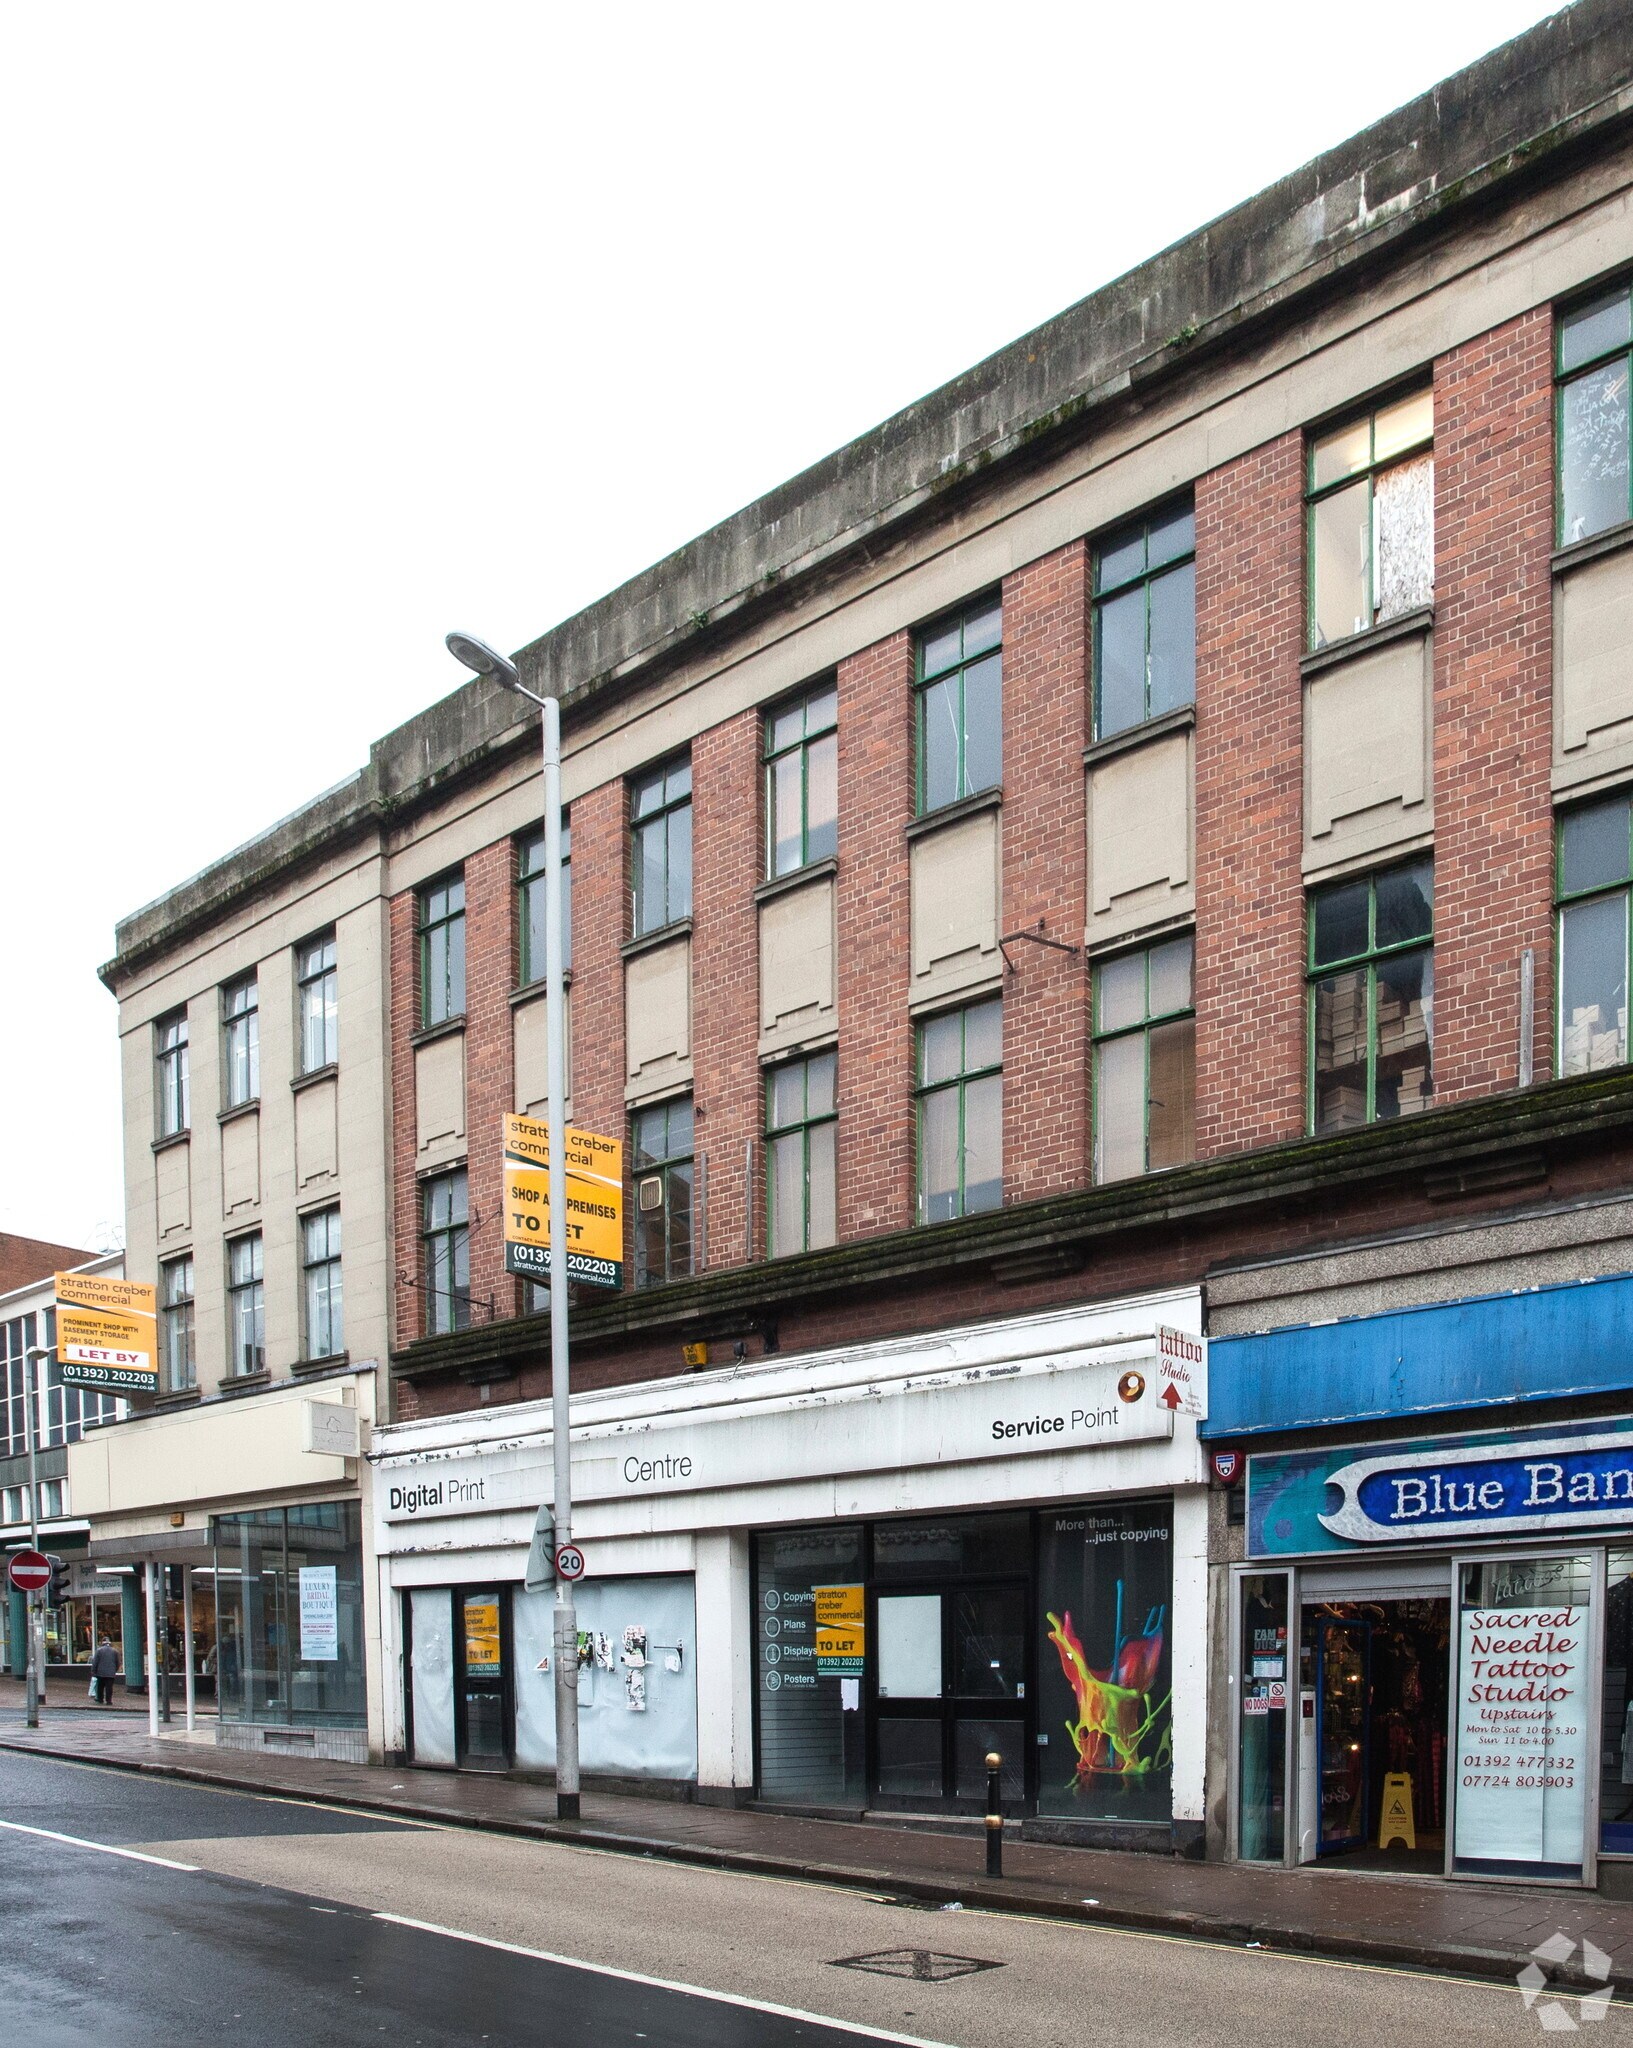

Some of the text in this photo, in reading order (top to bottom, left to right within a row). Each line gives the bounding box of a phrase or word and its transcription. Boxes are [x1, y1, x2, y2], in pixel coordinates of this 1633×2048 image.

[511, 1121, 616, 1154] stratt creber
[510, 1140, 593, 1166] commrcial
[512, 1186, 539, 1204] SHOP
[567, 1200, 616, 1220] PREMISES
[512, 1213, 540, 1232] TO
[513, 1245, 616, 1276] (0139 202203
[60, 1278, 152, 1297] stratton creber
[60, 1290, 131, 1305] commercial
[63, 1318, 139, 1334] PROMINENT SHOP WITH
[64, 1326, 130, 1340] BASEMENT STORAGE
[1159, 1327, 1203, 1363] tattoo
[79, 1349, 110, 1360] LET
[116, 1353, 139, 1363] BY
[63, 1365, 155, 1384] (01392) 202203
[1160, 1358, 1192, 1383] Studio
[992, 1406, 1119, 1440] Service Point
[390, 1456, 692, 1513] Digital Print Centre
[1390, 1474, 1505, 1519] Blue
[1056, 1518, 1124, 1531] More than...
[1086, 1527, 1168, 1544] ...just copying
[560, 1556, 580, 1570] 20
[305, 1583, 330, 1591] LUXURY
[307, 1592, 330, 1600] BRIDAL
[783, 1592, 816, 1602] Copying
[818, 1591, 847, 1599] stratton
[303, 1601, 334, 1609] BOUTIQUE
[818, 1601, 843, 1609] creber
[818, 1610, 862, 1619] commercial
[1470, 1606, 1580, 1630] Sacred
[783, 1620, 806, 1629] Plans
[1254, 1628, 1276, 1640] FAM
[820, 1641, 854, 1651] TO LET
[1471, 1633, 1578, 1654] Needle
[481, 1650, 493, 1658] LET
[784, 1646, 817, 1656] Displays
[817, 1658, 840, 1666] (01392)
[841, 1658, 864, 1666] 202203
[1471, 1660, 1575, 1679] Tattoo
[784, 1674, 815, 1683] Posters
[1468, 1682, 1574, 1703] Studio
[1245, 1699, 1252, 1710] NO
[1253, 1698, 1268, 1710] DOGS
[1480, 1708, 1556, 1724] Upstairs
[1466, 1725, 1577, 1735] Mon to Sat 10 to 5.30
[1478, 1736, 1500, 1744] Sun
[1519, 1736, 1530, 1745] to
[1532, 1737, 1554, 1746] 4.00
[1464, 1756, 1574, 1769] 01392 477332
[1463, 1776, 1574, 1788] 07724 803903
